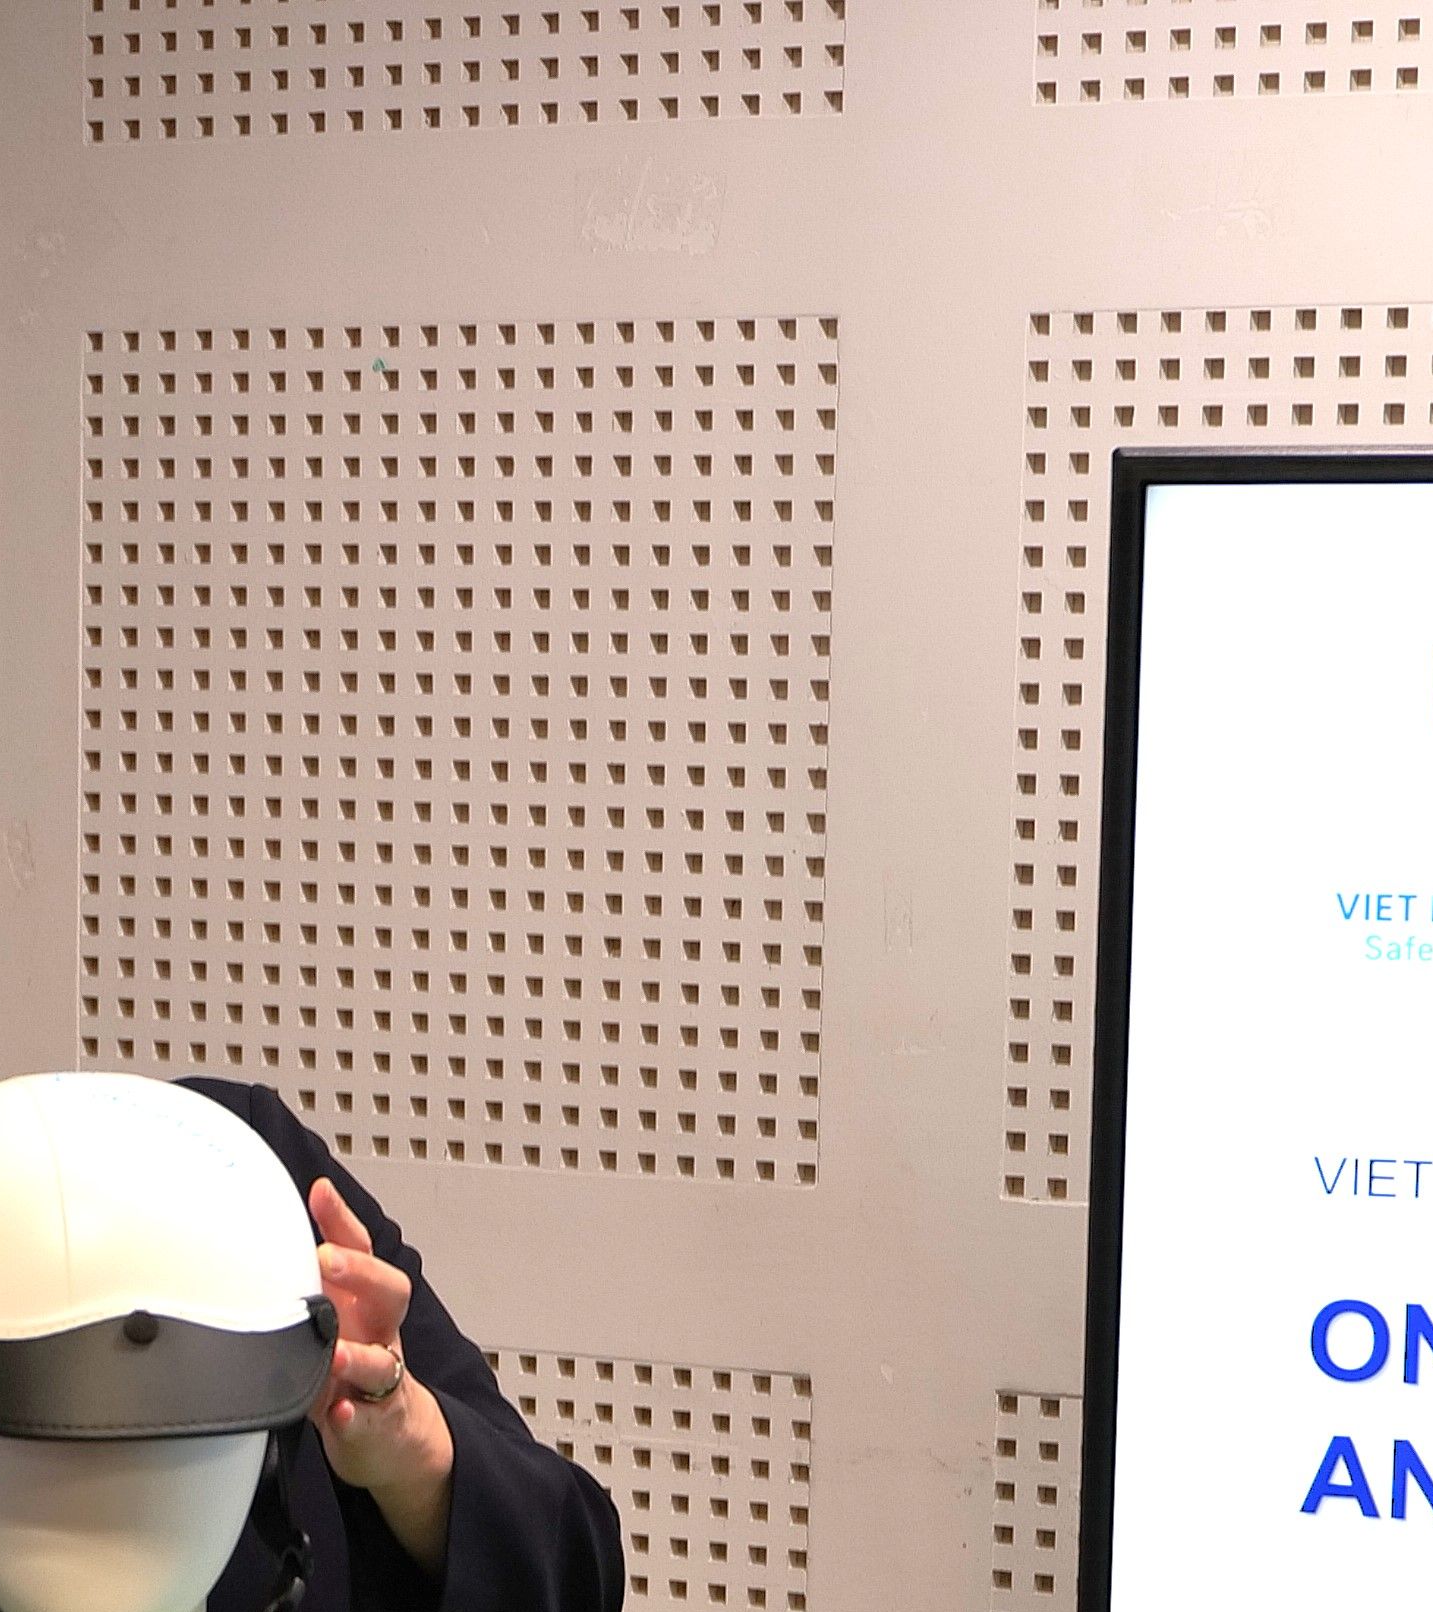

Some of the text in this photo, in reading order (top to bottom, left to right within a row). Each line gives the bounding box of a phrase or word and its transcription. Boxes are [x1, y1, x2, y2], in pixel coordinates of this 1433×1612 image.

[1337, 893, 1417, 921] VIET
[1366, 935, 1433, 960] Safe
[1314, 1157, 1432, 1198] VIET
